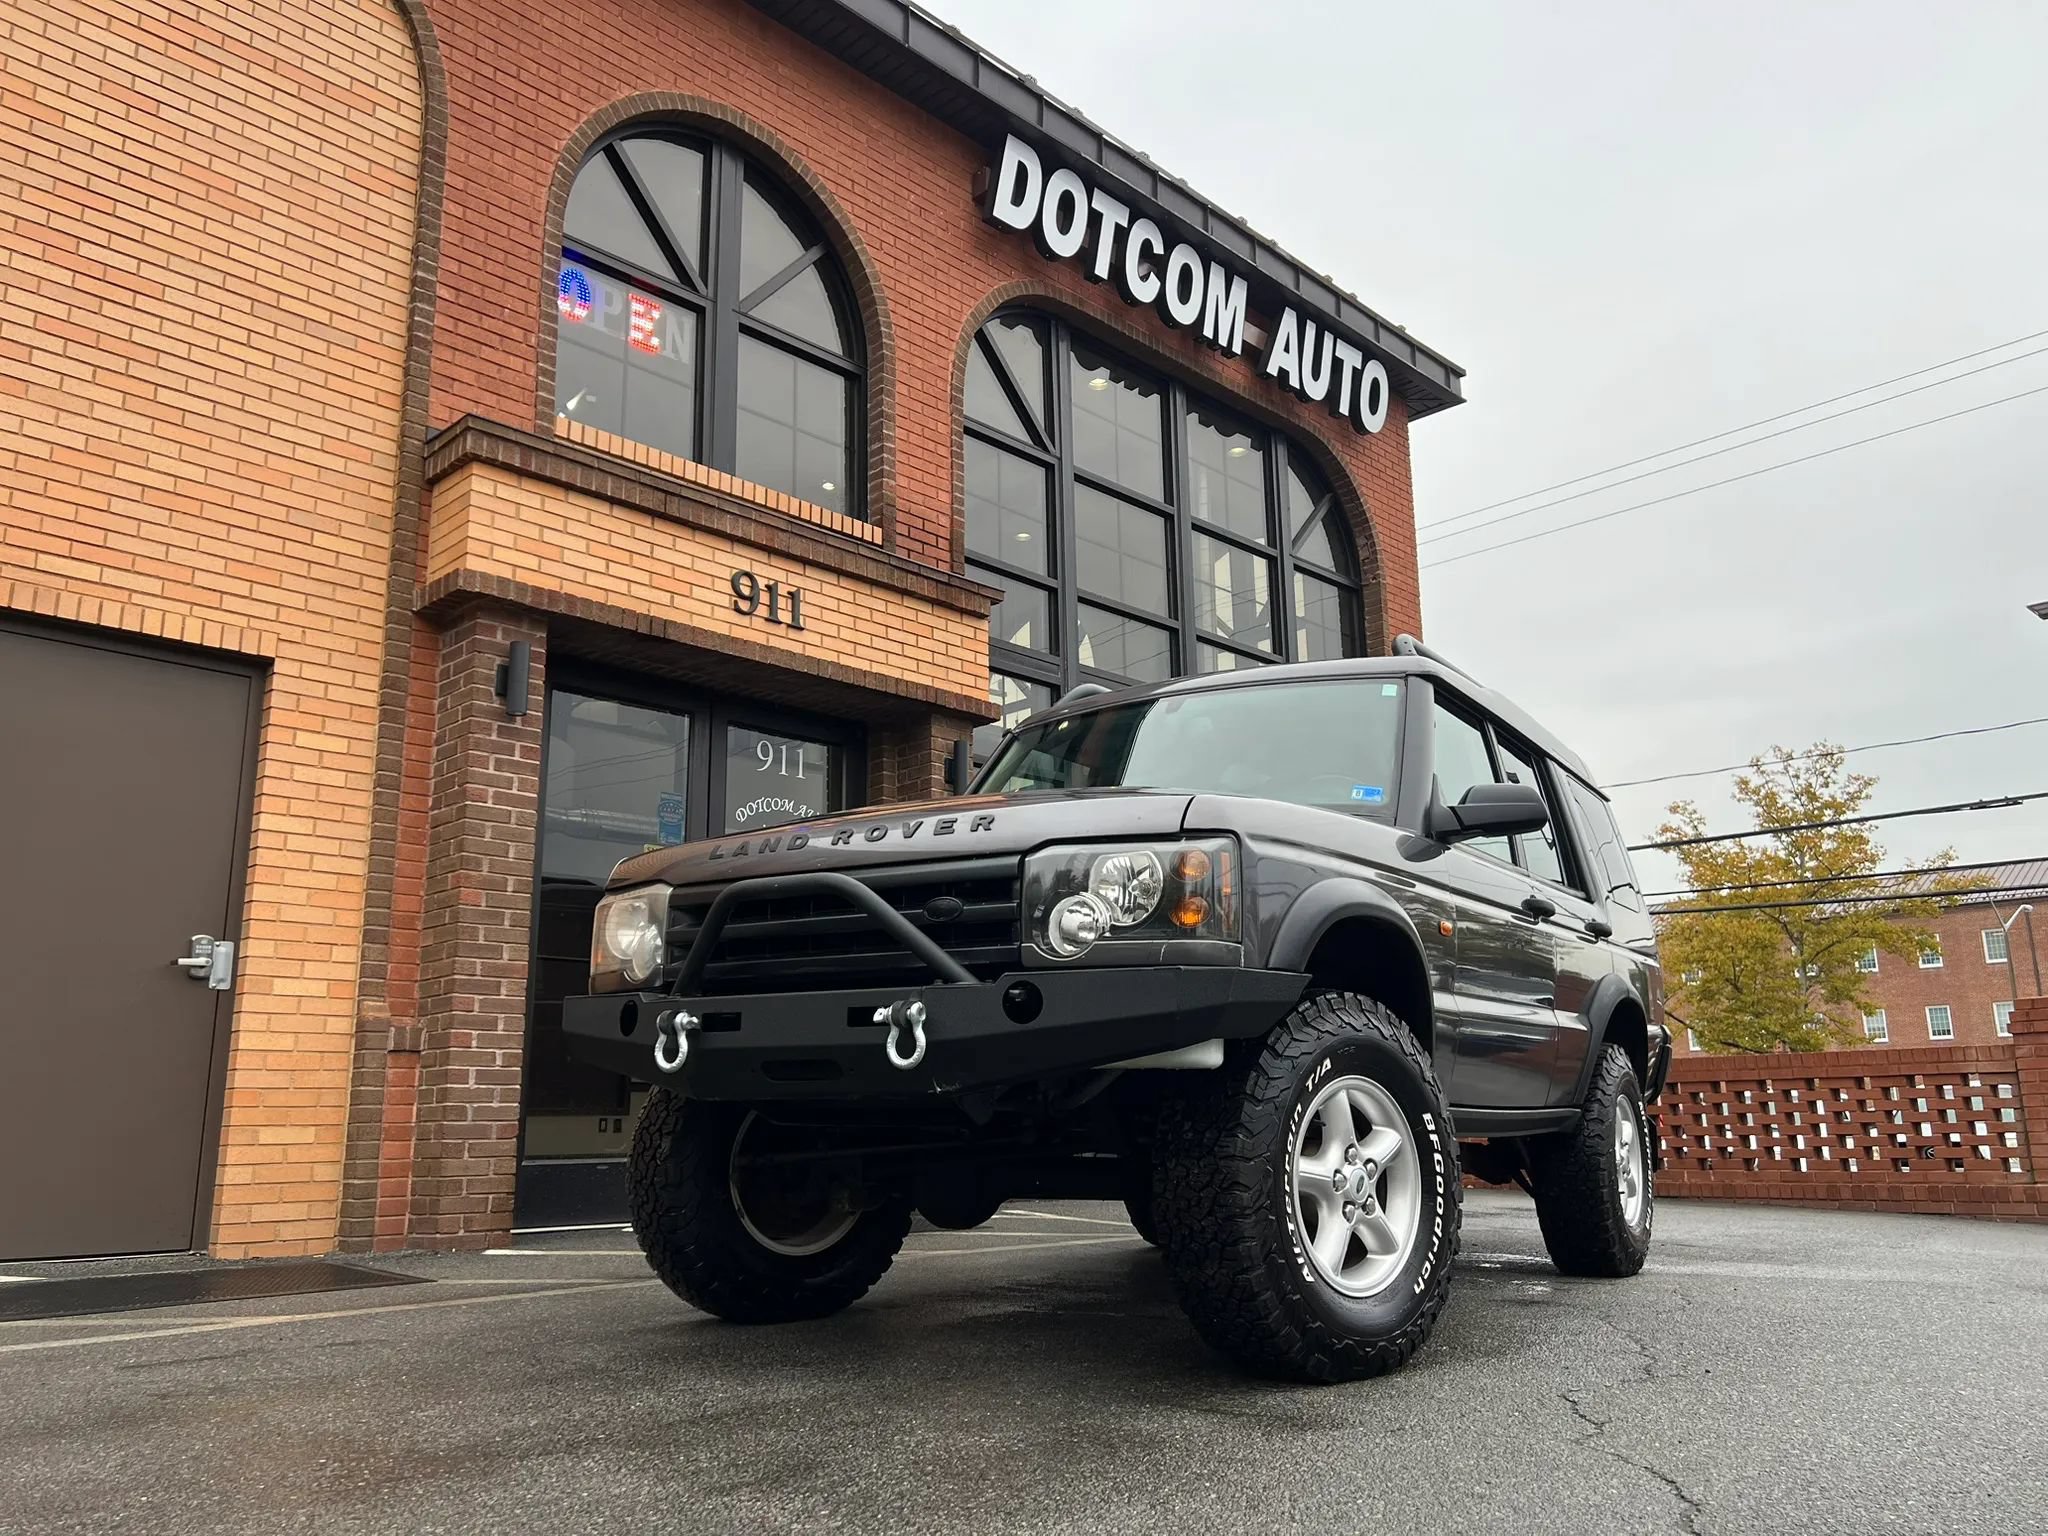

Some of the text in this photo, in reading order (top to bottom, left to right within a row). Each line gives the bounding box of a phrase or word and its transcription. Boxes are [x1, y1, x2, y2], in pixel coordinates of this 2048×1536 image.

[992, 133, 1390, 434] DOTCOM AUTO
[557, 268, 691, 365] OPEN
[730, 569, 806, 632] 911
[756, 740, 806, 780] 911
[735, 796, 795, 823] DOTCOM
[708, 833, 810, 861] LAND
[831, 814, 995, 846] ROVER
[1305, 1057, 1332, 1093] T/A
[1413, 1112, 1445, 1295] BFGoodrich
